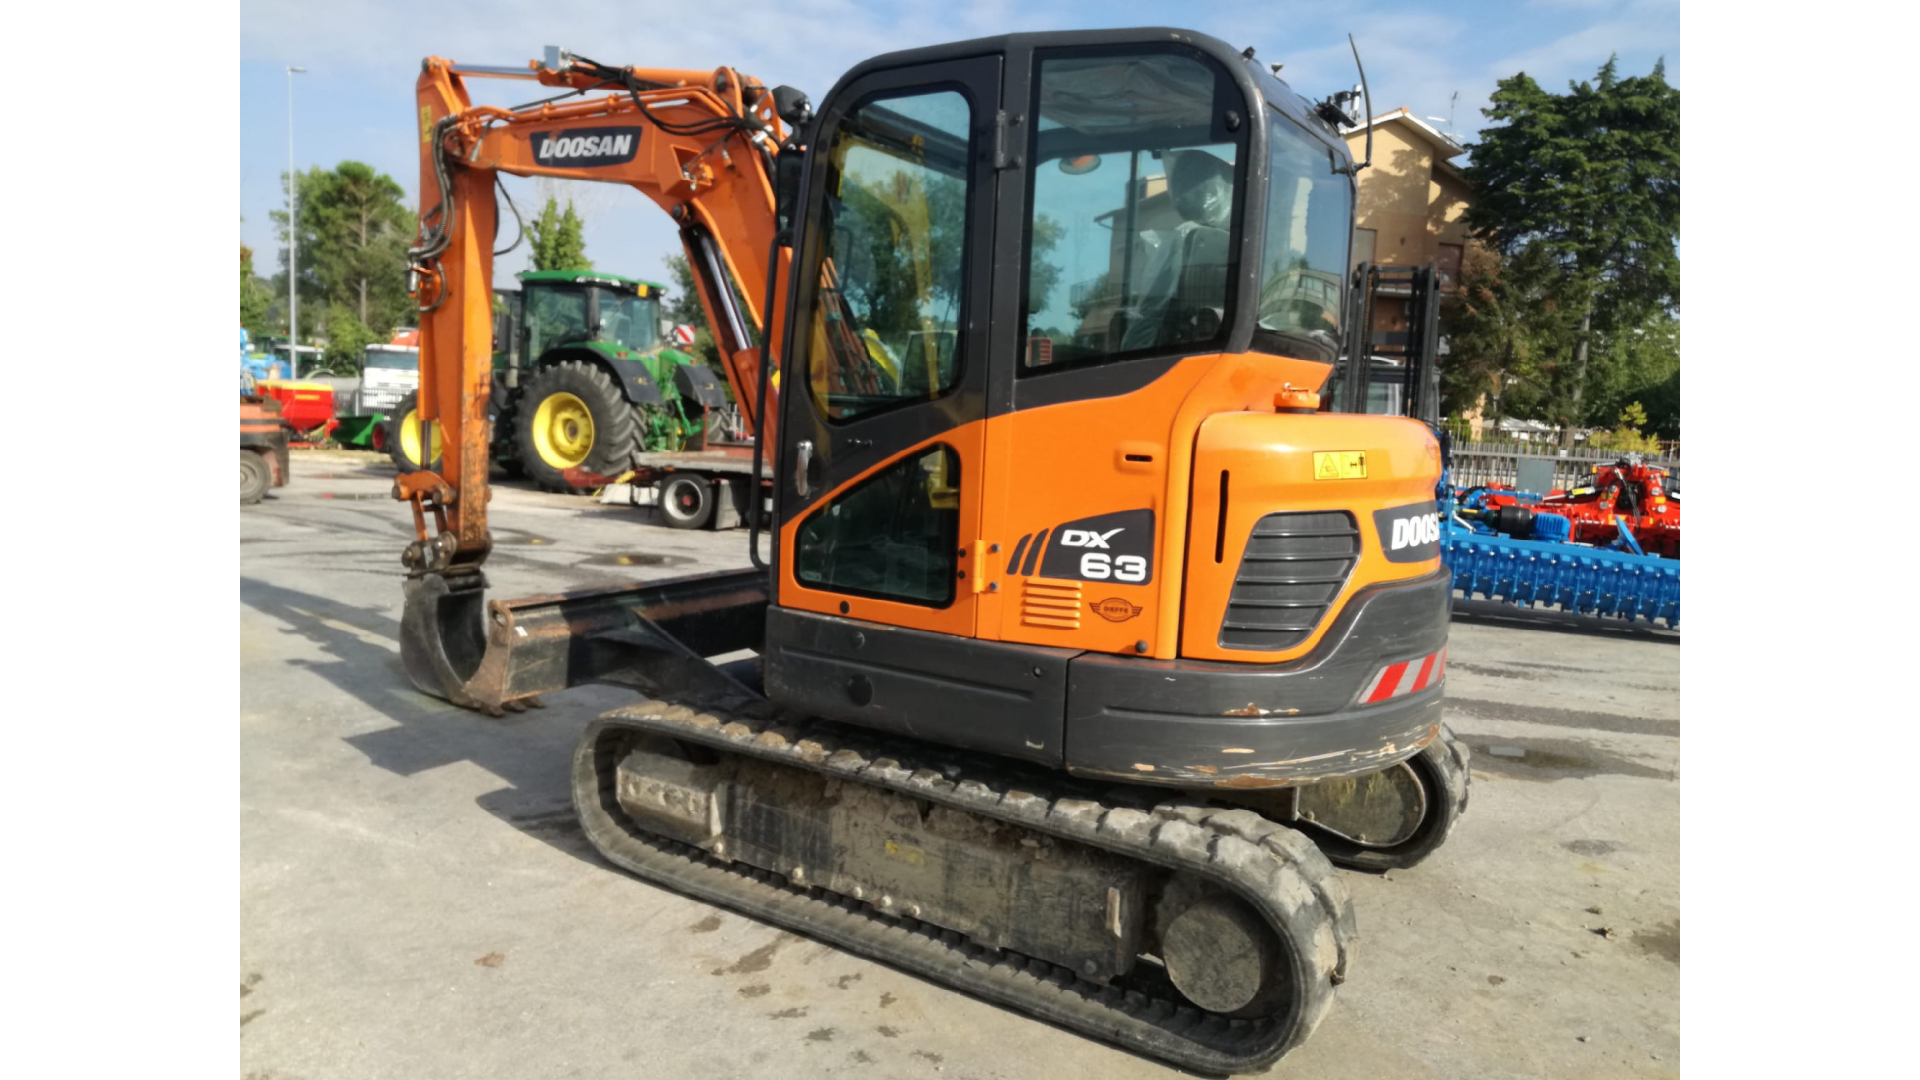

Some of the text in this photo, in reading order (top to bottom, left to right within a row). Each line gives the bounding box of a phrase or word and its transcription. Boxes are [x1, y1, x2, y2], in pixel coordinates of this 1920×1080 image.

[539, 135, 632, 158] DOOSAN
[1061, 528, 1125, 549] DX
[1080, 552, 1146, 582] 63
